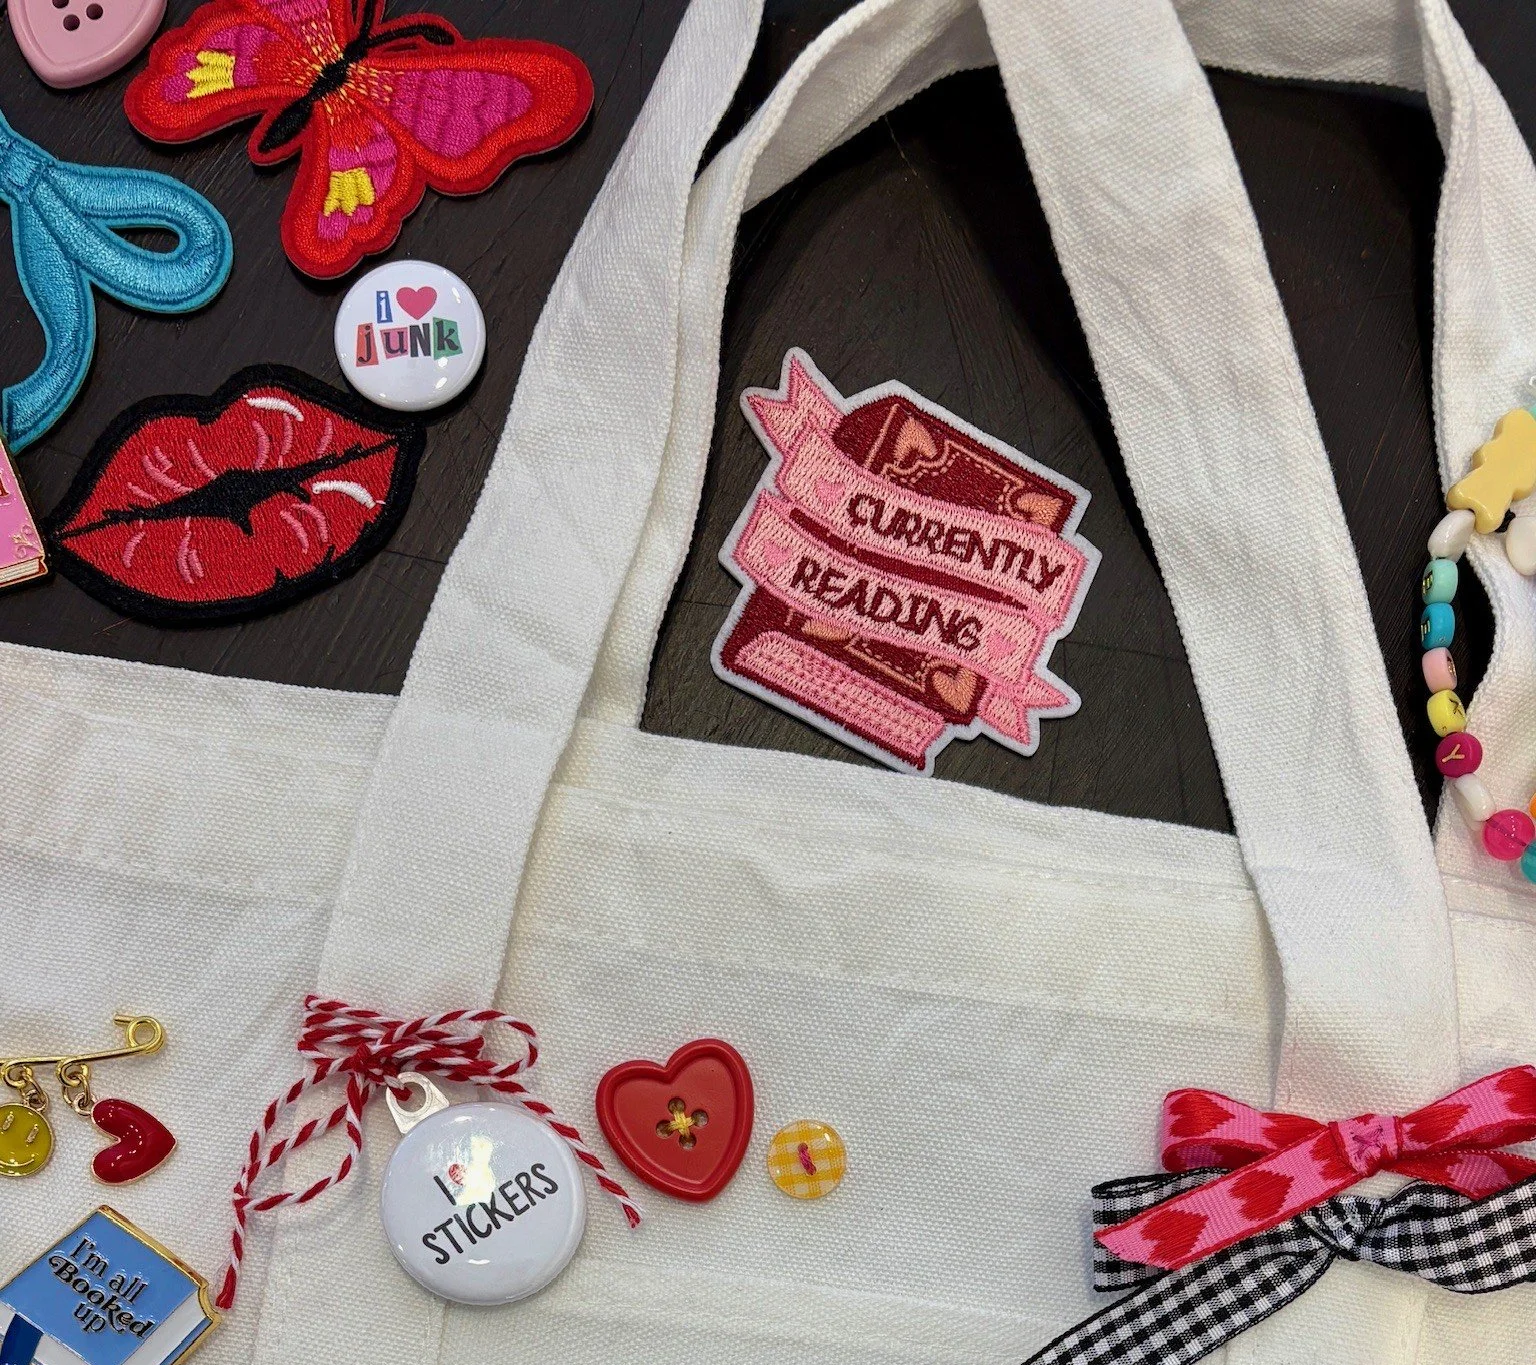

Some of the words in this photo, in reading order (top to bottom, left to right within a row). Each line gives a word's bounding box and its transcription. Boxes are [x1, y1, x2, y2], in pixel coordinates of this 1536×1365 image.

[848, 492, 1065, 593] CURRENTLY
[790, 555, 982, 651] READING
[421, 1163, 559, 1265] STICKERS
[433, 1175, 457, 1206] I
[48, 1254, 156, 1339] Booked
[70, 1236, 109, 1277] I'm
[108, 1272, 148, 1304] all
[72, 1303, 106, 1335] up
